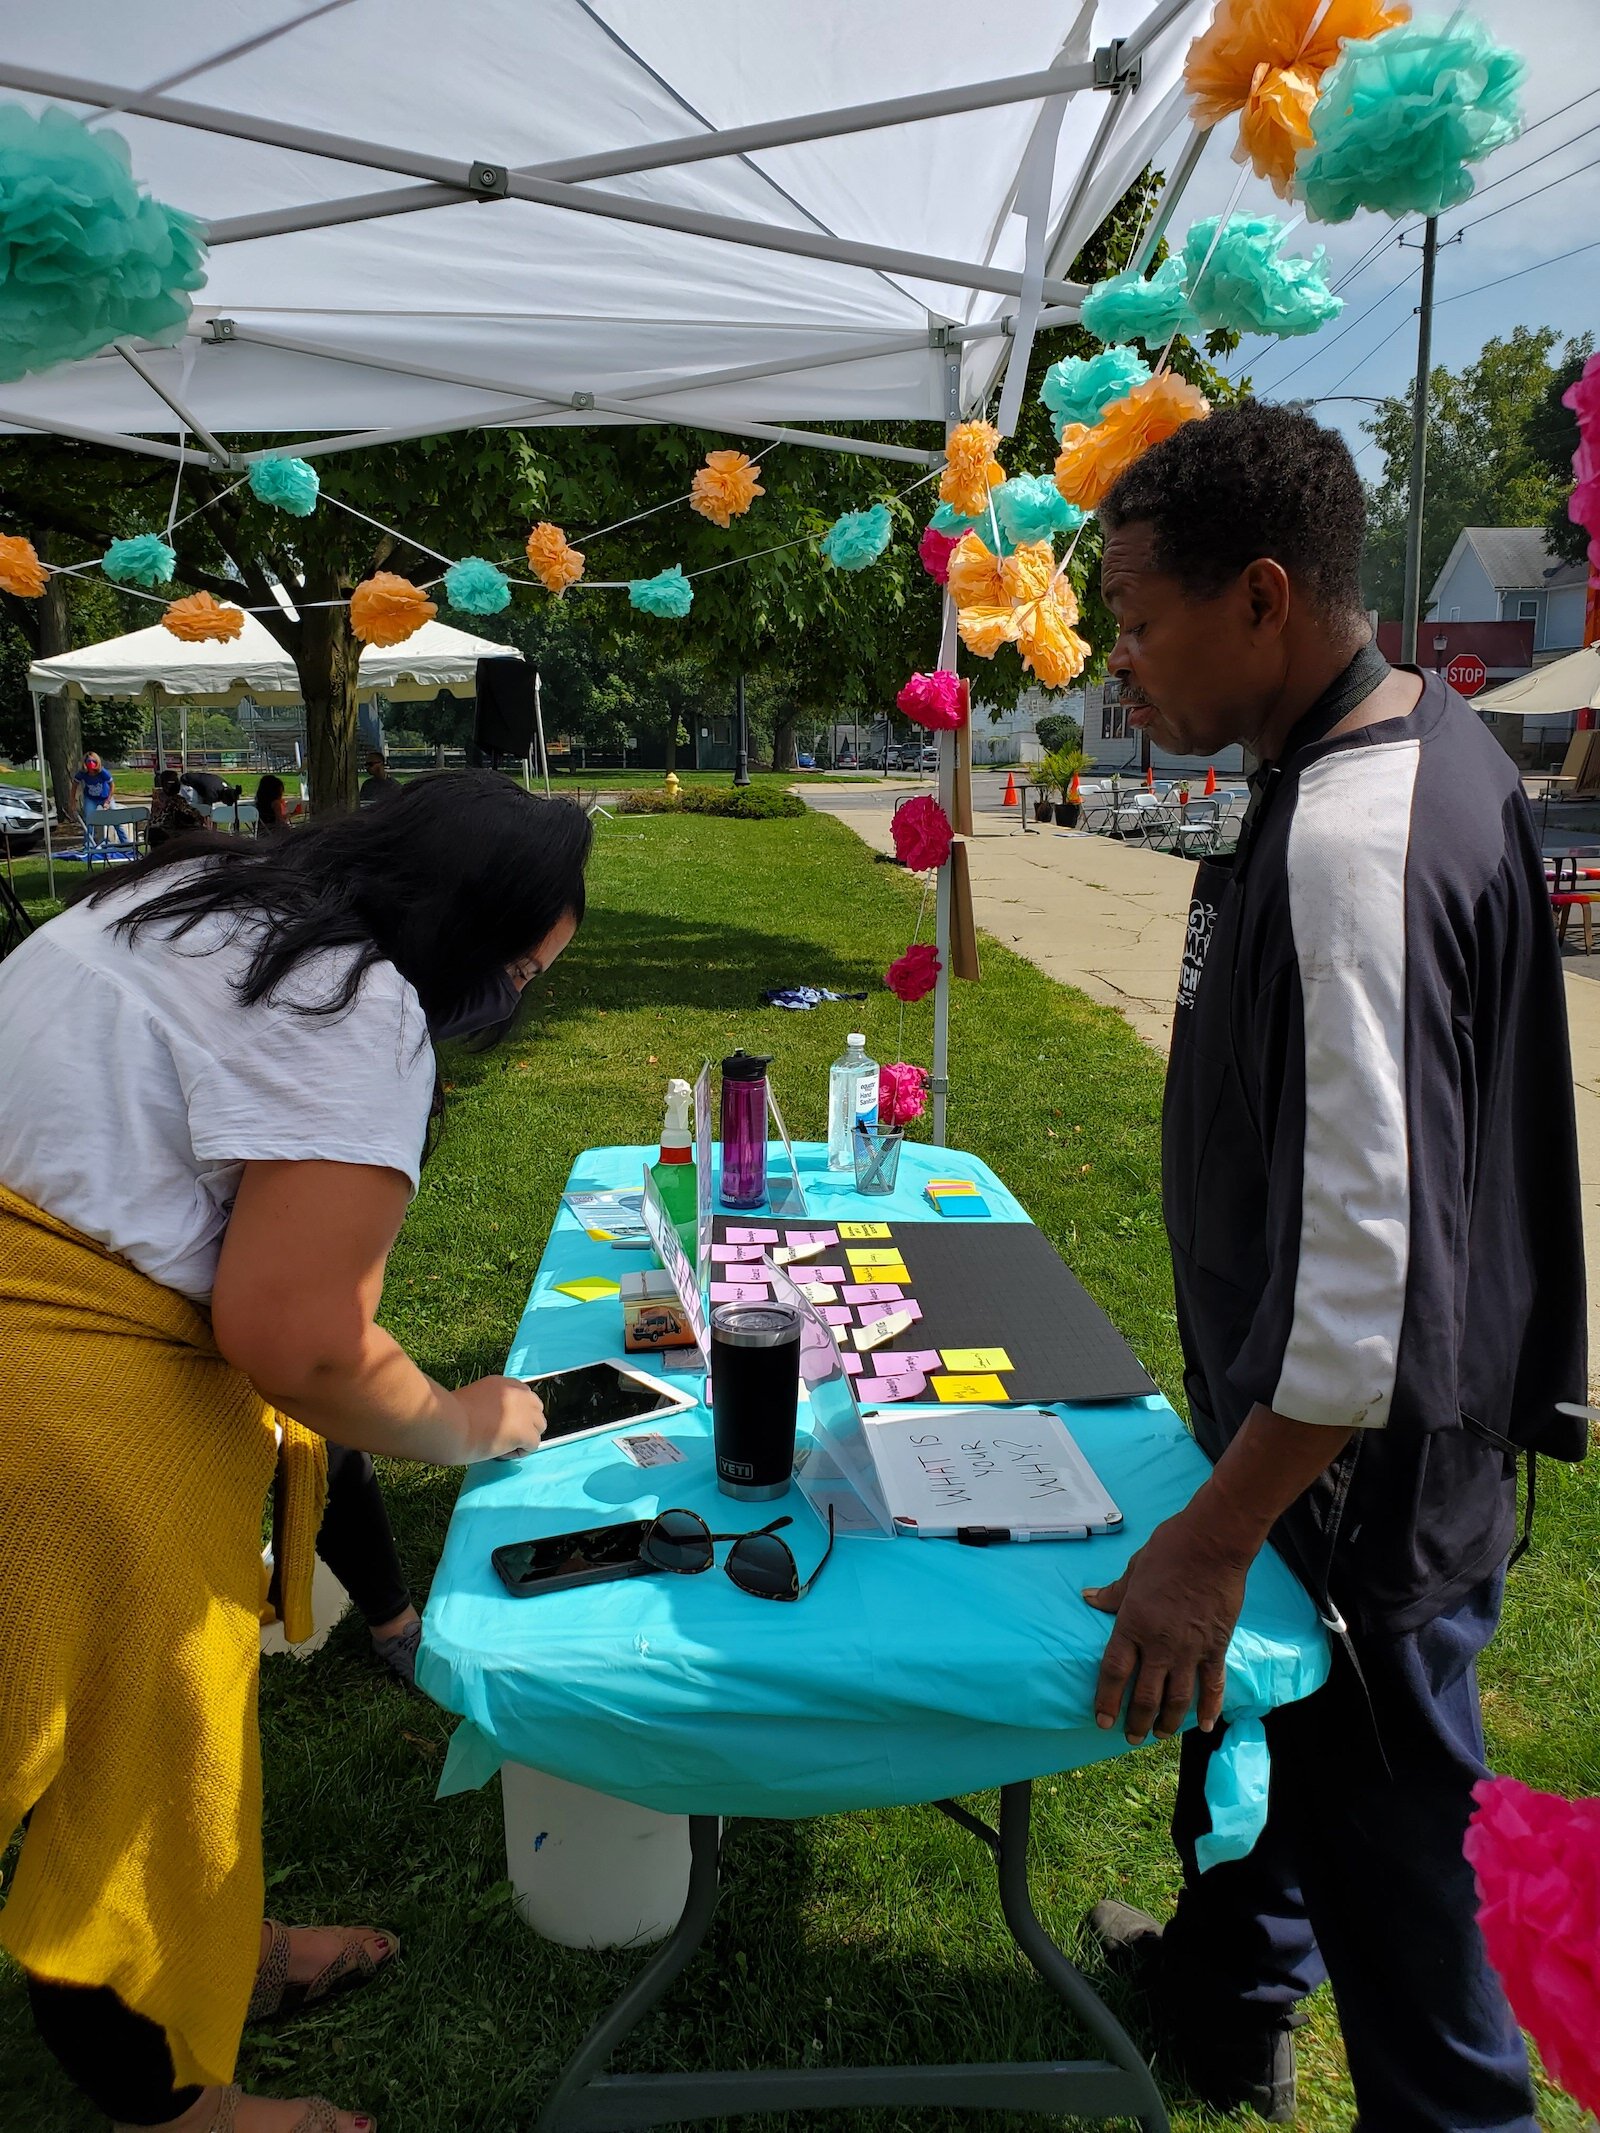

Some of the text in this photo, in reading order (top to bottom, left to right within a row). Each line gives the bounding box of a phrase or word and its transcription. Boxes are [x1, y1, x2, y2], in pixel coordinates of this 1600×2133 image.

[1450, 667, 1484, 683] STOP
[721, 1460, 750, 1476] YETI
[909, 1434, 972, 1507] WHAT IS
[961, 1439, 1003, 1477] YOUR
[993, 1439, 1068, 1499] WHY?
